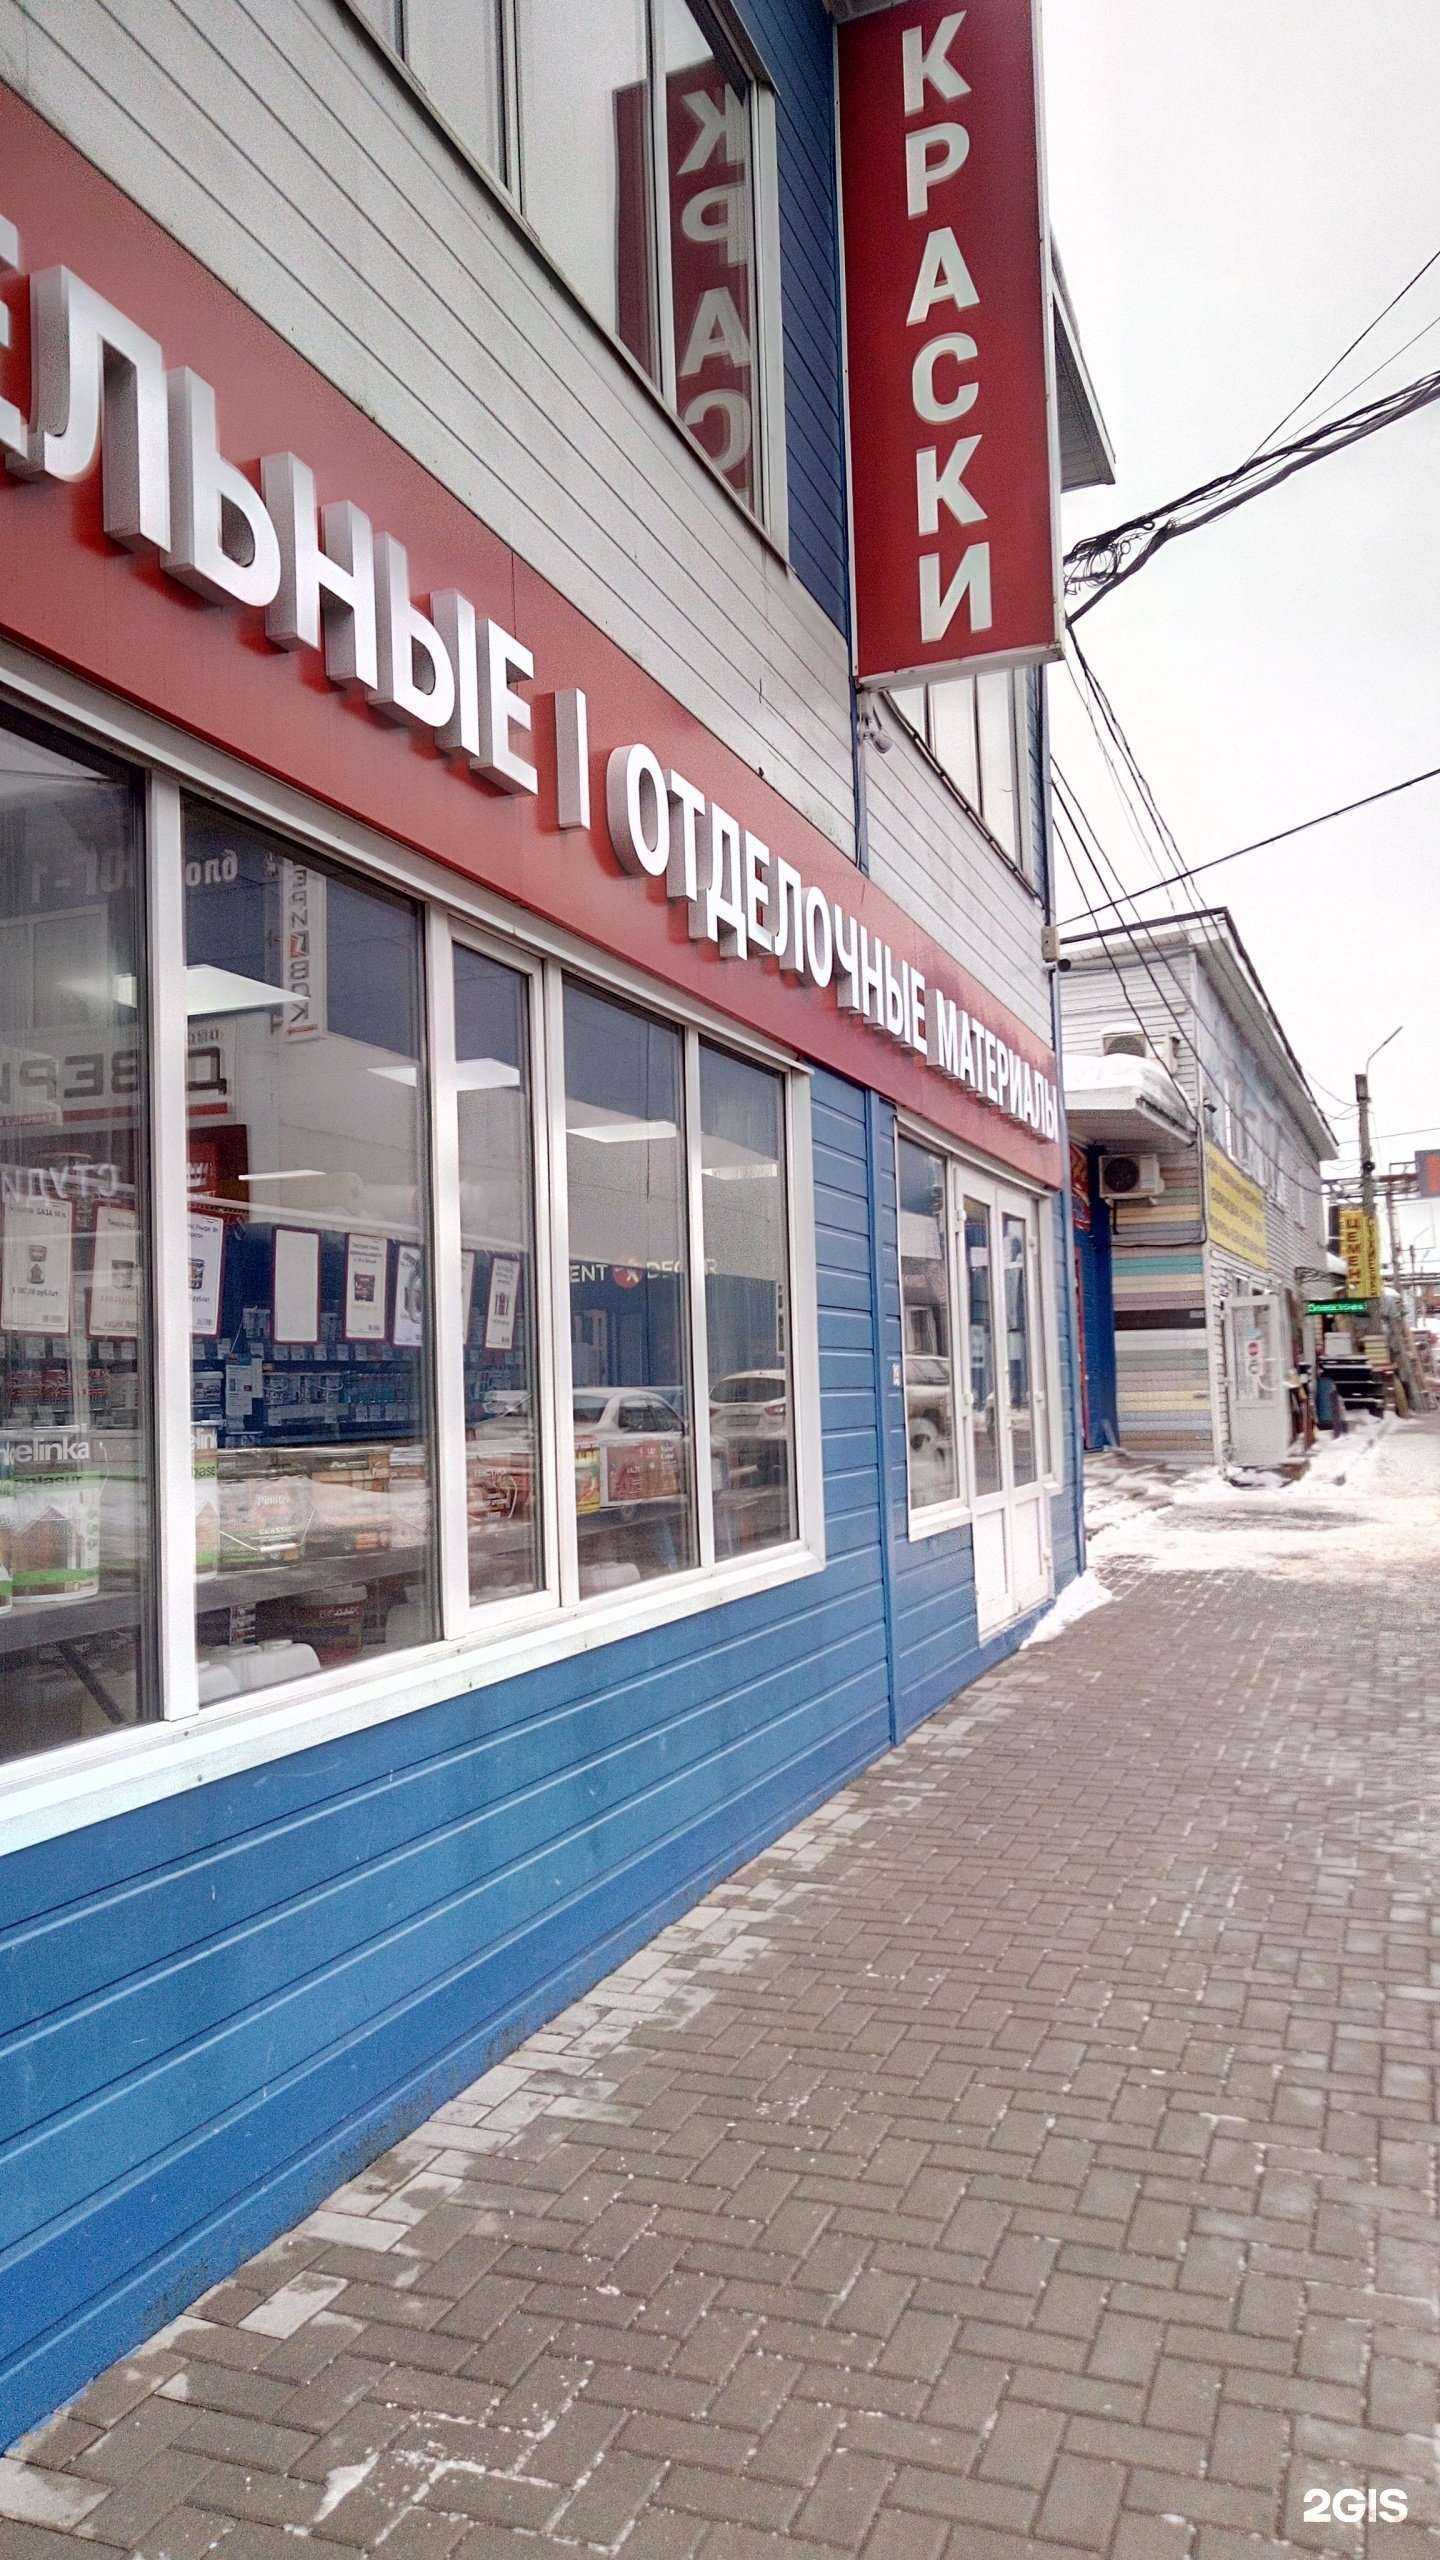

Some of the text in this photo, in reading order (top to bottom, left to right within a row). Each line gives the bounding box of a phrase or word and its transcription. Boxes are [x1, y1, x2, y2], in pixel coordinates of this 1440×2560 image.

[902, 9, 992, 644] КРАСКИ
[606, 743, 927, 1055] ОТДЕЛОЧНЫЕ
[927, 988, 1058, 1142] МАТЕРИАЛЫ
